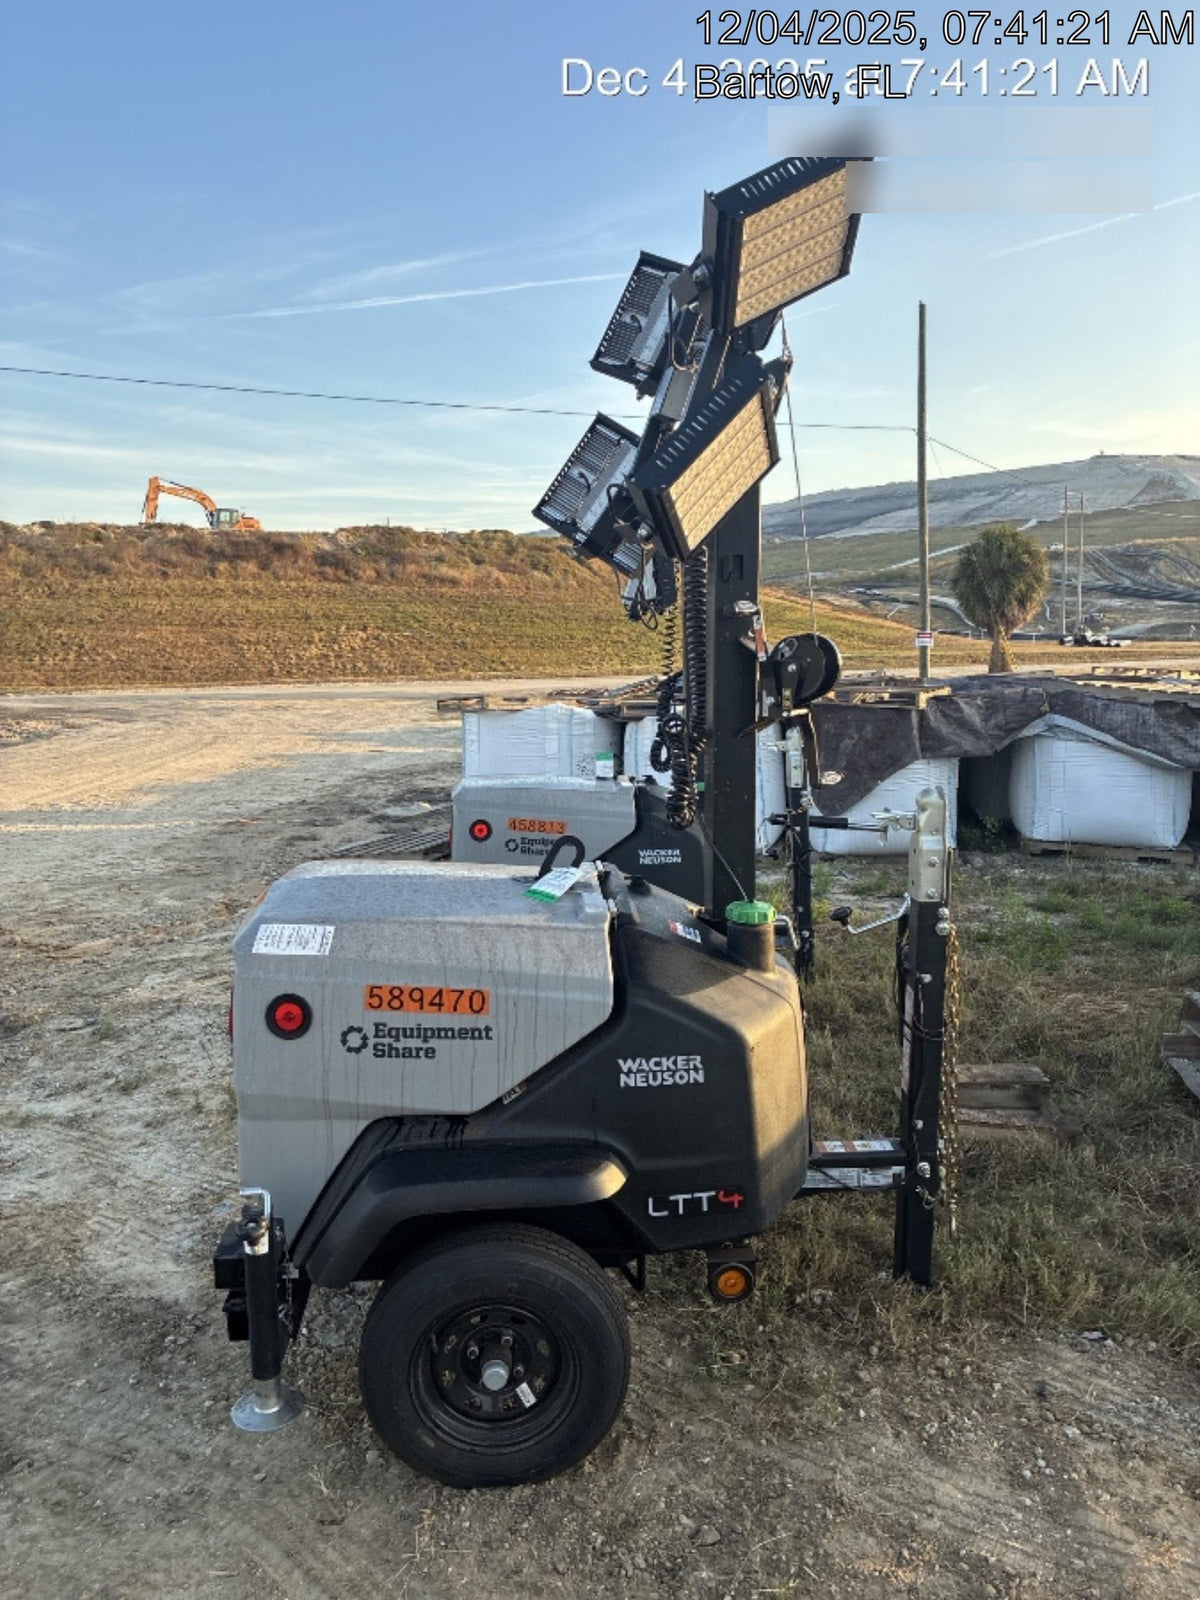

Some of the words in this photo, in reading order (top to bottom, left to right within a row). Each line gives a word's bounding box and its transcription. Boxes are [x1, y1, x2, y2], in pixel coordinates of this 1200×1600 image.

[367, 985, 487, 1015] 589470
[372, 1022, 493, 1044] Equipment
[372, 1043, 436, 1060] Share
[617, 1055, 704, 1072] WACKER
[619, 1069, 705, 1088] NEUSON
[647, 1190, 744, 1218] LTT4
